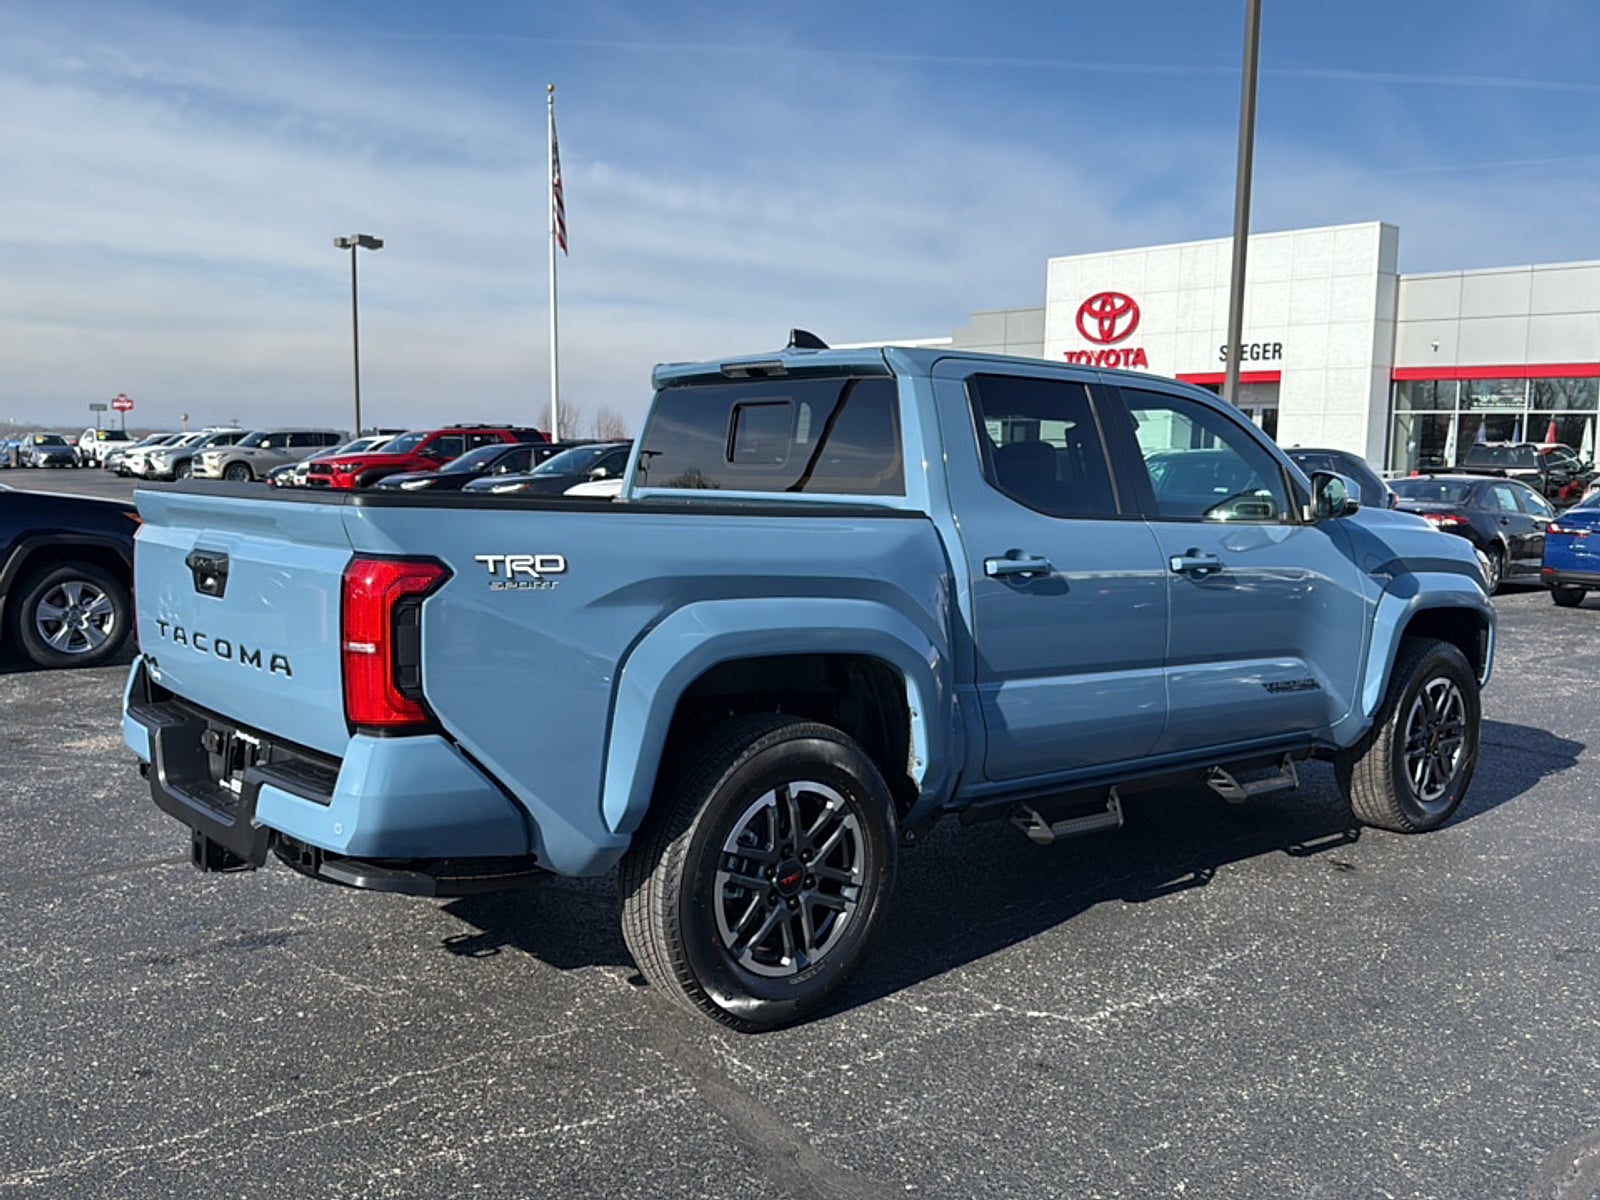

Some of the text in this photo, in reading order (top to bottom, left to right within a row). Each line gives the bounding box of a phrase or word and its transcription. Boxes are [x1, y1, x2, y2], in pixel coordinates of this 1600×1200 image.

[1063, 347, 1149, 369] TOYOTA
[1219, 342, 1283, 362] SEGER
[474, 555, 567, 579] TRD
[489, 581, 560, 591] SPORT
[156, 619, 294, 678] TACOMA
